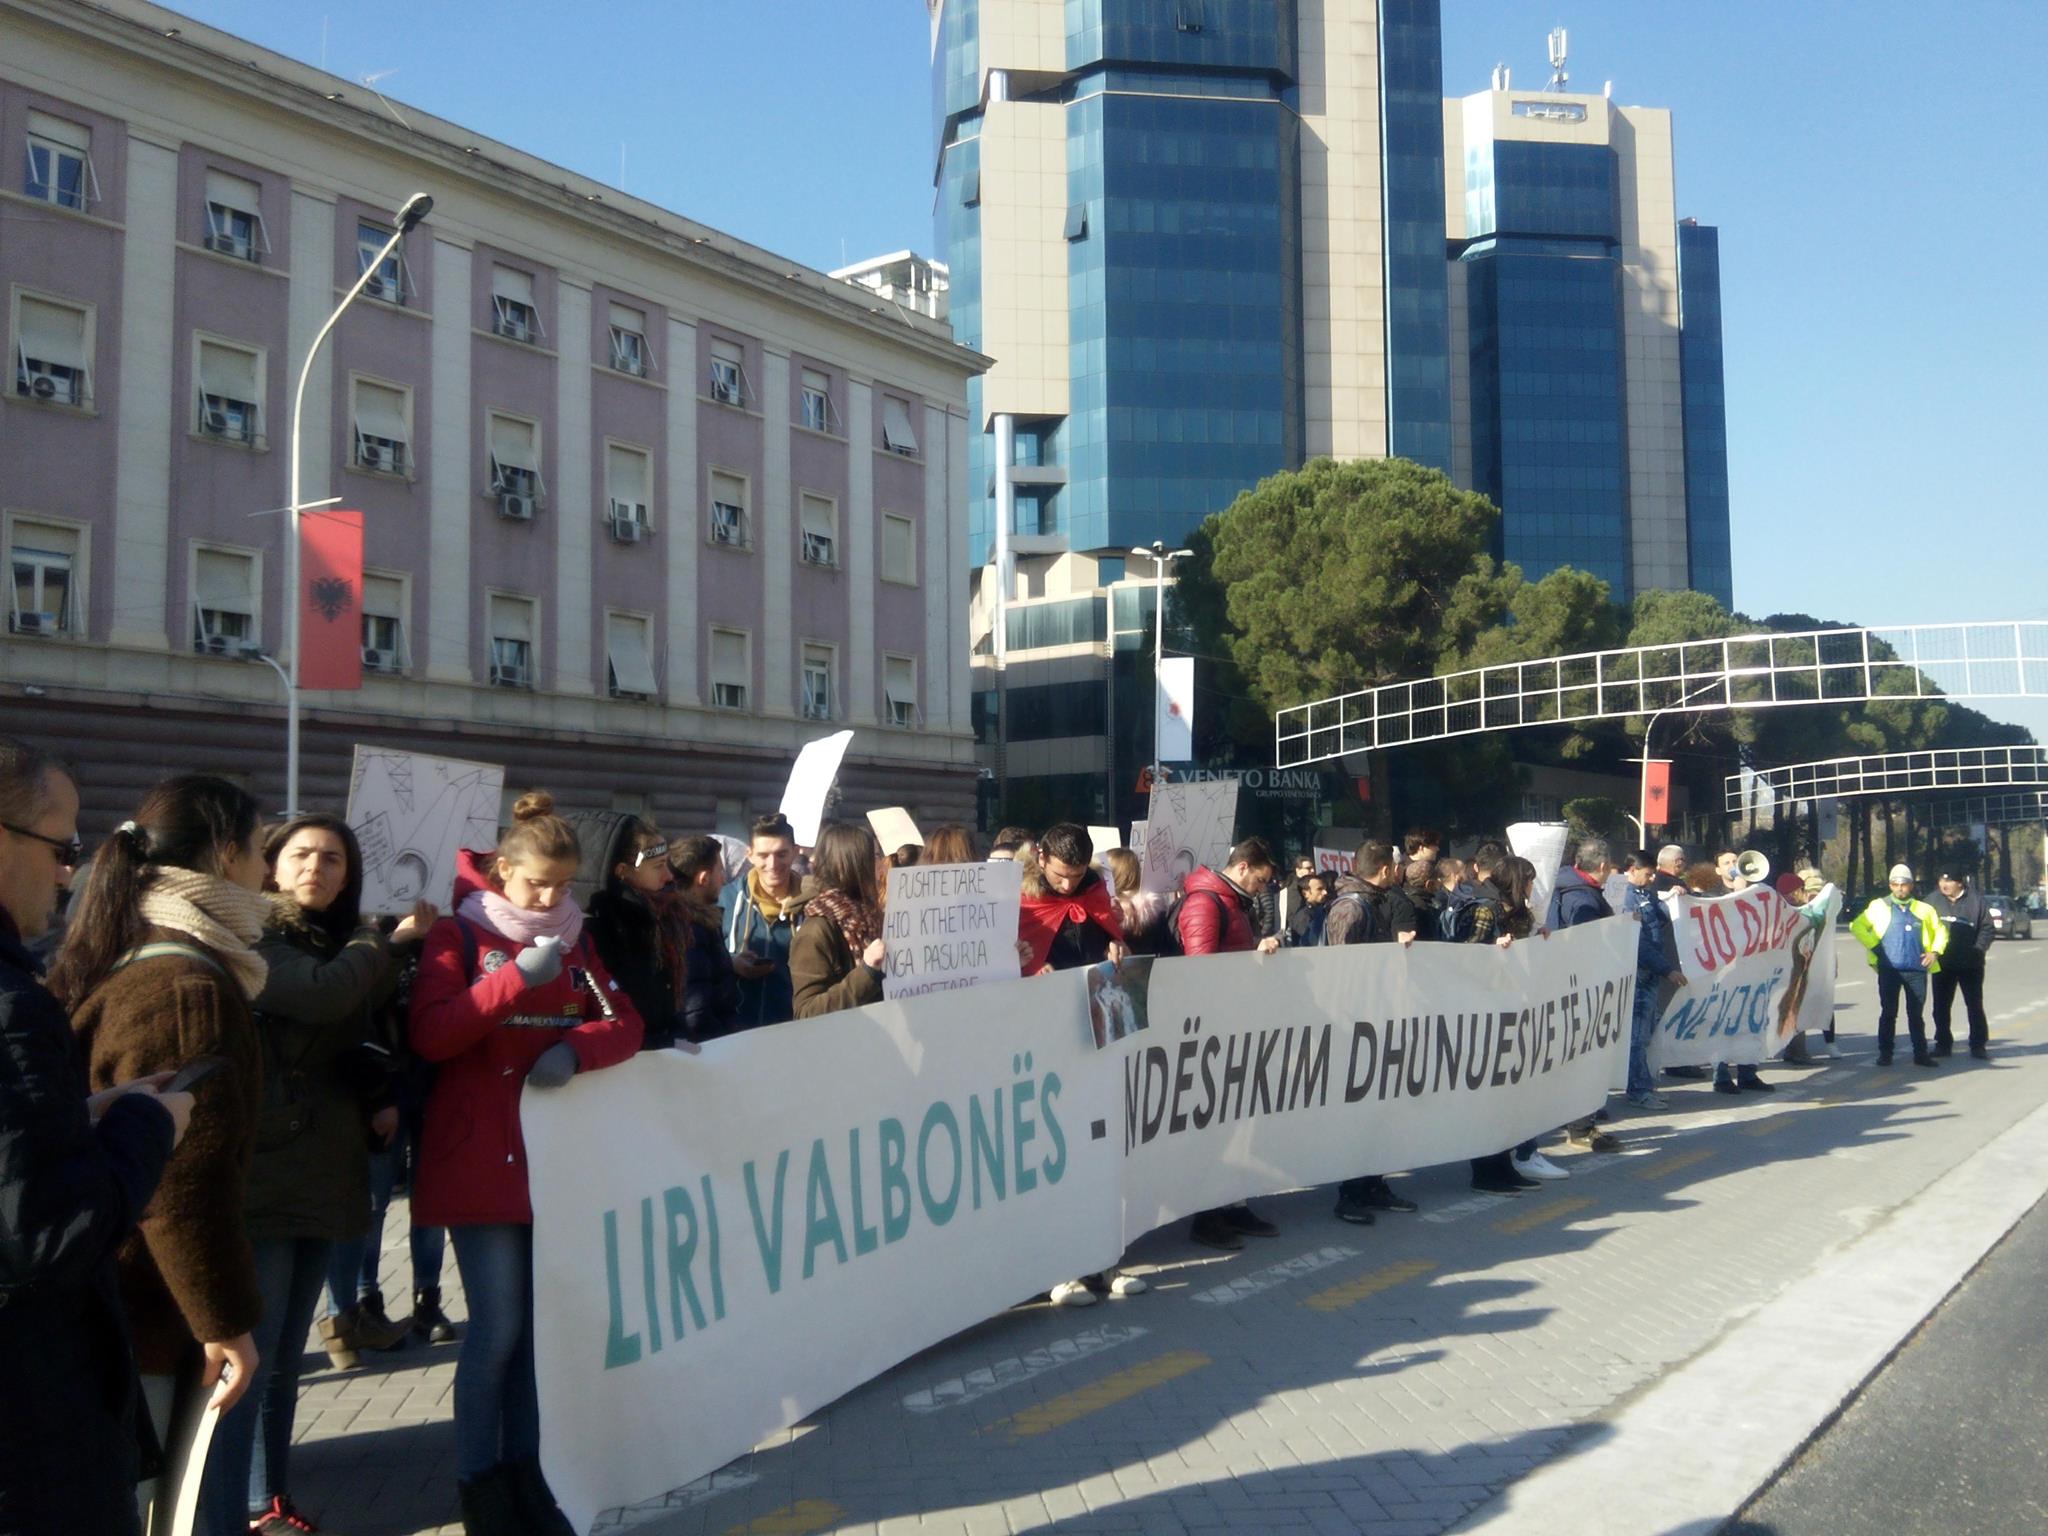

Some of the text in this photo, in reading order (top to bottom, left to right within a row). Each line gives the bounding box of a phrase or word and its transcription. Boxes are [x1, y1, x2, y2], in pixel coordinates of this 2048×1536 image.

[1179, 769, 1321, 790] VENETO BANKA
[920, 902, 999, 936] KTHETRAT
[1689, 902, 1737, 972] JO
[884, 940, 988, 978] NGA PASURIA
[603, 1174, 726, 1370] LIRI
[743, 1051, 1067, 1295] VALBONËS
[1125, 1016, 1332, 1157] NDËSHKIM
[1344, 1000, 1555, 1104] DHUNUESVE
[1560, 973, 1581, 1066] TË
